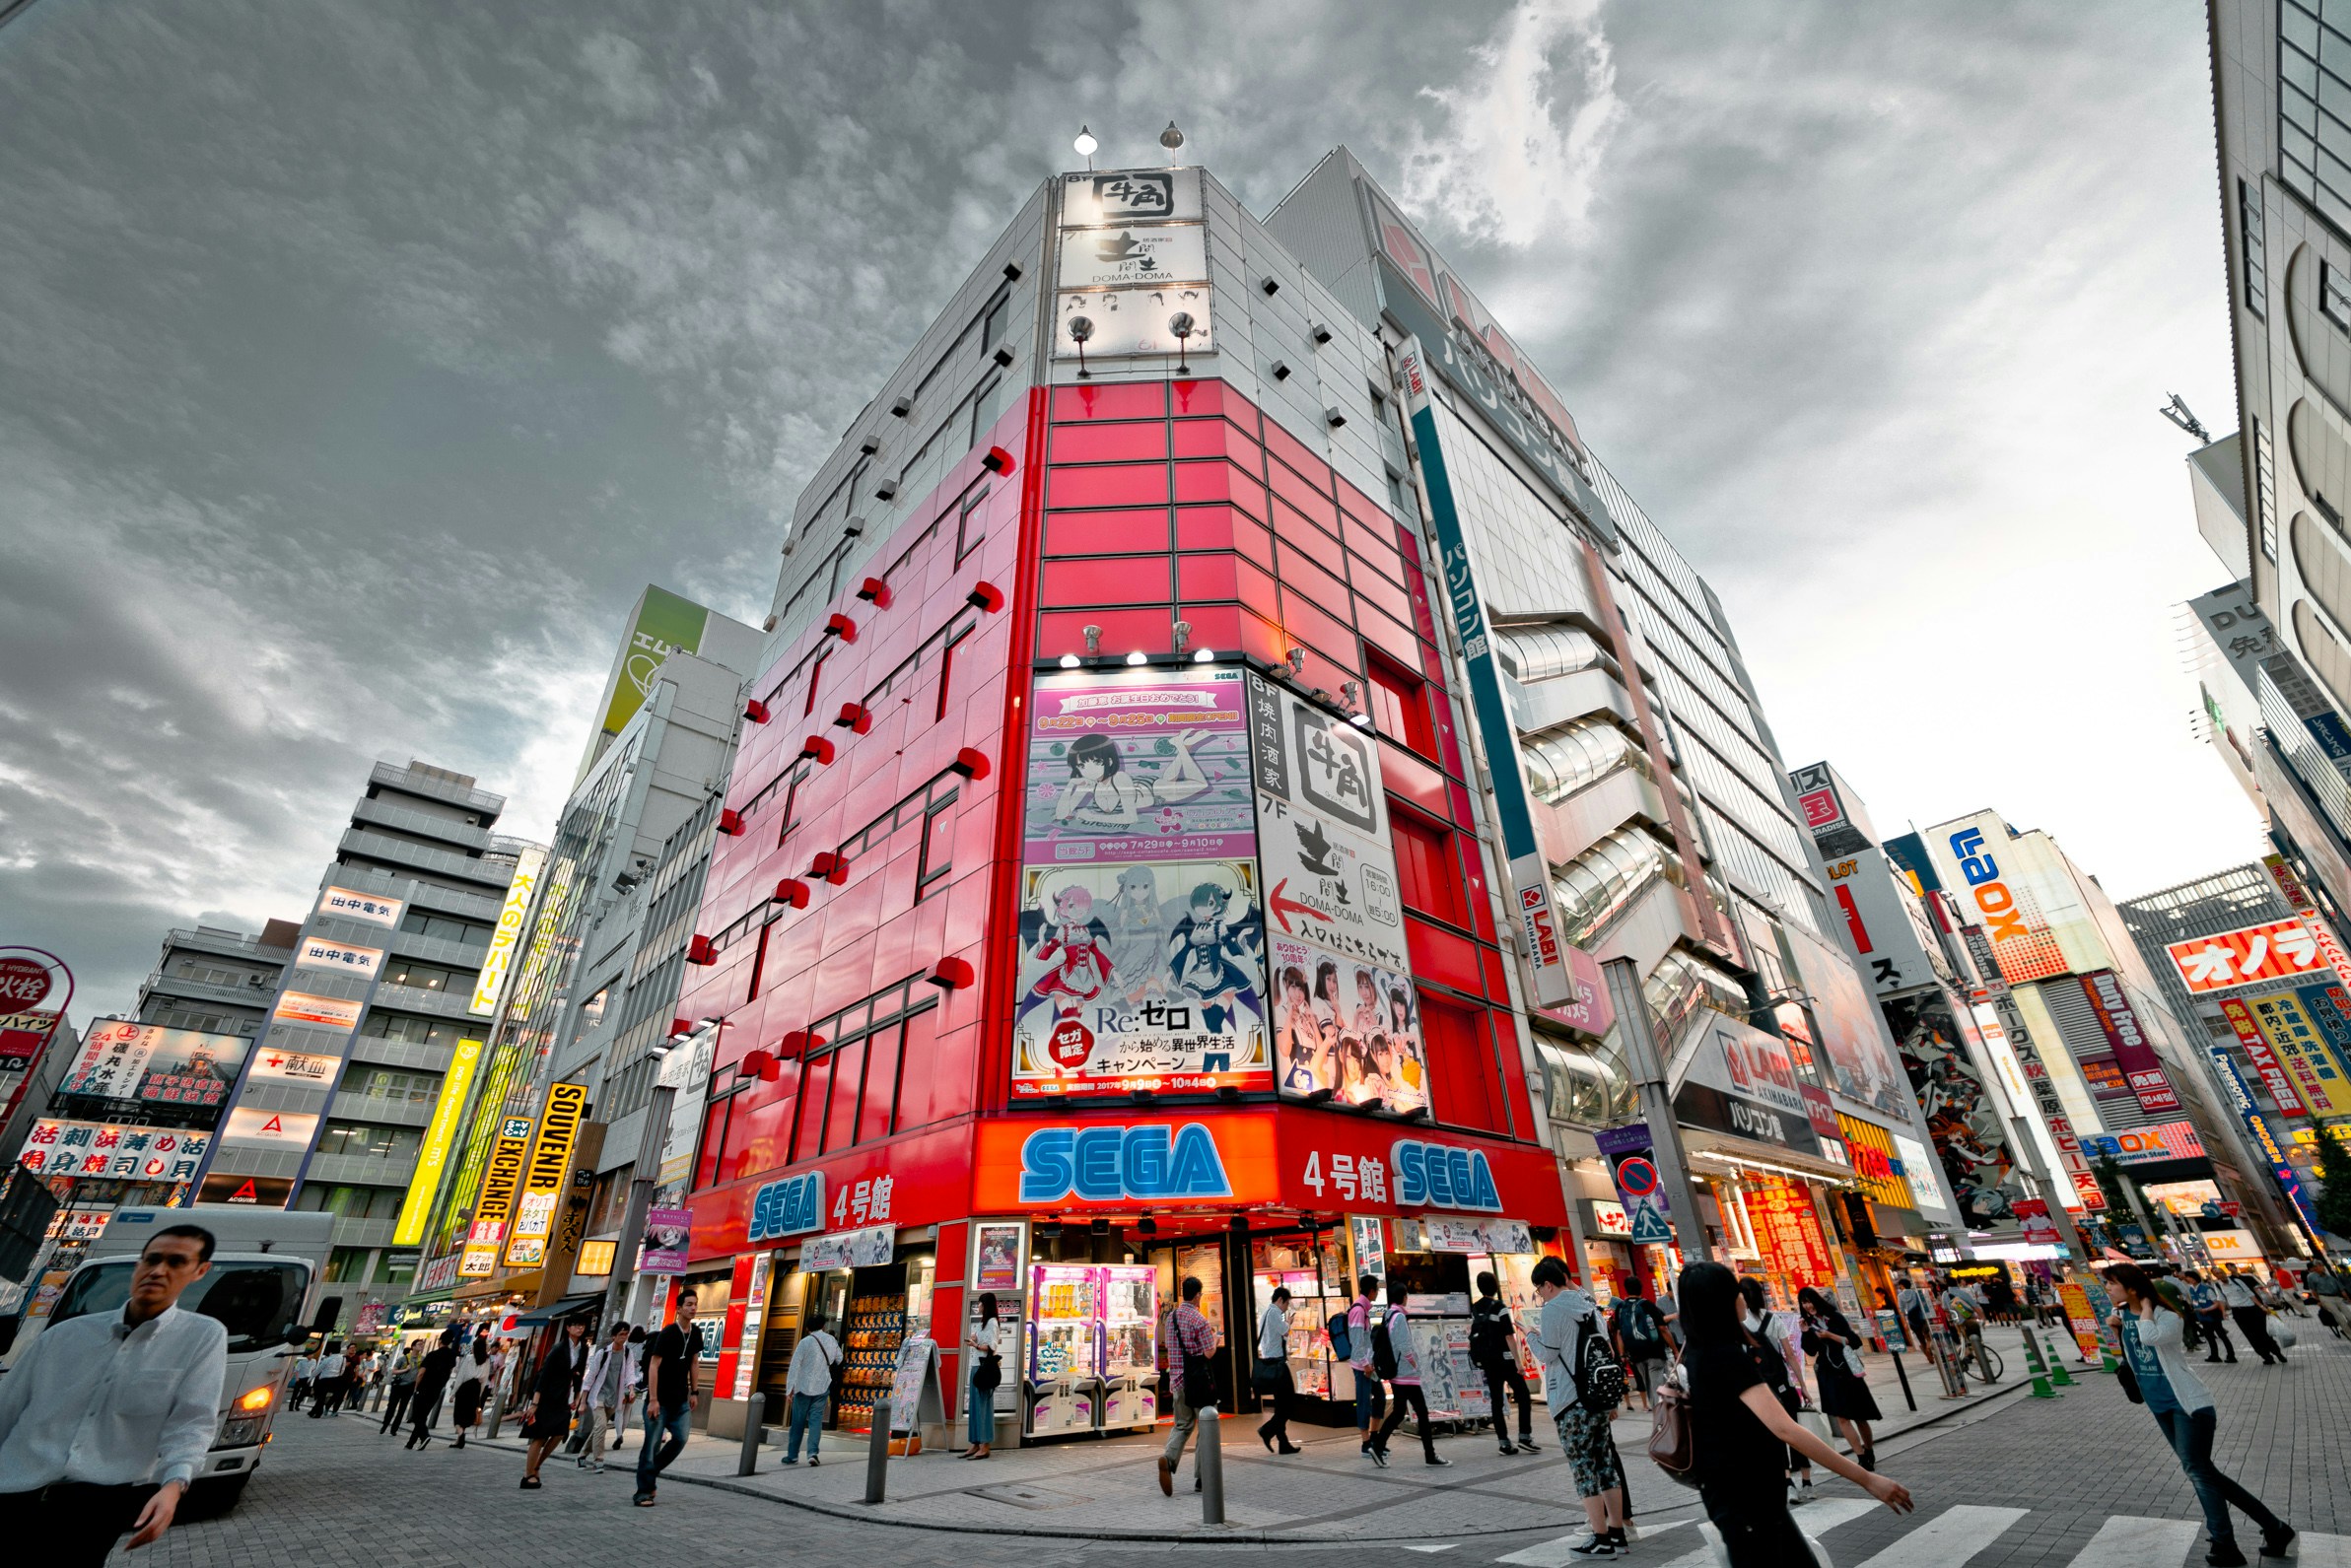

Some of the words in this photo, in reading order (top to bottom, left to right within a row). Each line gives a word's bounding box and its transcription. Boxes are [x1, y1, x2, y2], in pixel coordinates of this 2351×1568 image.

[1092, 272, 1173, 283] DOMA-DOMA
[1409, 364, 1424, 394] LABI
[1442, 542, 1489, 662] パソコン館
[2209, 602, 2260, 632] DU
[1252, 676, 1277, 697] 8F
[1307, 730, 1367, 808] 牛角
[1260, 793, 1287, 819] 7F
[1813, 820, 1848, 837] ARADISE
[330, 895, 391, 918] 田中電気
[1300, 891, 1364, 926] DOMA-DOMA
[1365, 878, 1391, 898] 16:00
[309, 946, 371, 967] 田中電気
[474, 874, 534, 1009] 大人のデパート
[1276, 942, 1308, 954] ありがとう
[1524, 915, 1543, 970] AKIHABARA
[1533, 910, 1559, 967] LABI
[1962, 927, 1993, 979] PARADISE
[1970, 923, 1993, 960] HOBBY
[7, 964, 45, 975] HYDRANT
[1097, 998, 1191, 1034] Re:ゼロ
[2082, 979, 2103, 1009] Flagship
[2099, 1009, 2114, 1033] Store
[2093, 974, 2124, 1011] Duty
[2111, 1010, 2143, 1047] Free
[1057, 1028, 1082, 1045] セガ
[1059, 1045, 1085, 1059] 限定
[1119, 1036, 1235, 1054] から始める異世界生活
[2225, 1003, 2256, 1034] 免税
[2244, 1035, 2275, 1067] TAX
[2262, 1067, 2301, 1111] FREE
[69, 1032, 111, 1091] 24時間営業中
[93, 1042, 128, 1093] 磯丸水産
[285, 1055, 326, 1075] 献血
[1096, 1057, 1186, 1074] キャンペーン
[1742, 1040, 1798, 1092] LABI
[2215, 1054, 2252, 1110] Panasonic
[1758, 1085, 1805, 1113] AKIHABARA
[530, 1086, 583, 1189] SOUVENIR
[1728, 1101, 1786, 1142] パソコン館
[2249, 1115, 2285, 1165] ONODEN
[50, 1127, 93, 1173] 刺身
[145, 1135, 176, 1176] めし
[1018, 1122, 1234, 1203] SEGA
[479, 1138, 525, 1220] EXCHANGE
[1302, 1150, 1387, 1204] 4号館
[1391, 1138, 1503, 1213] SEGA
[228, 1195, 258, 1204] ACQUIRE
[747, 1170, 825, 1243] SEGA
[832, 1174, 894, 1227] 4号館
[464, 1262, 491, 1271] 太郎
